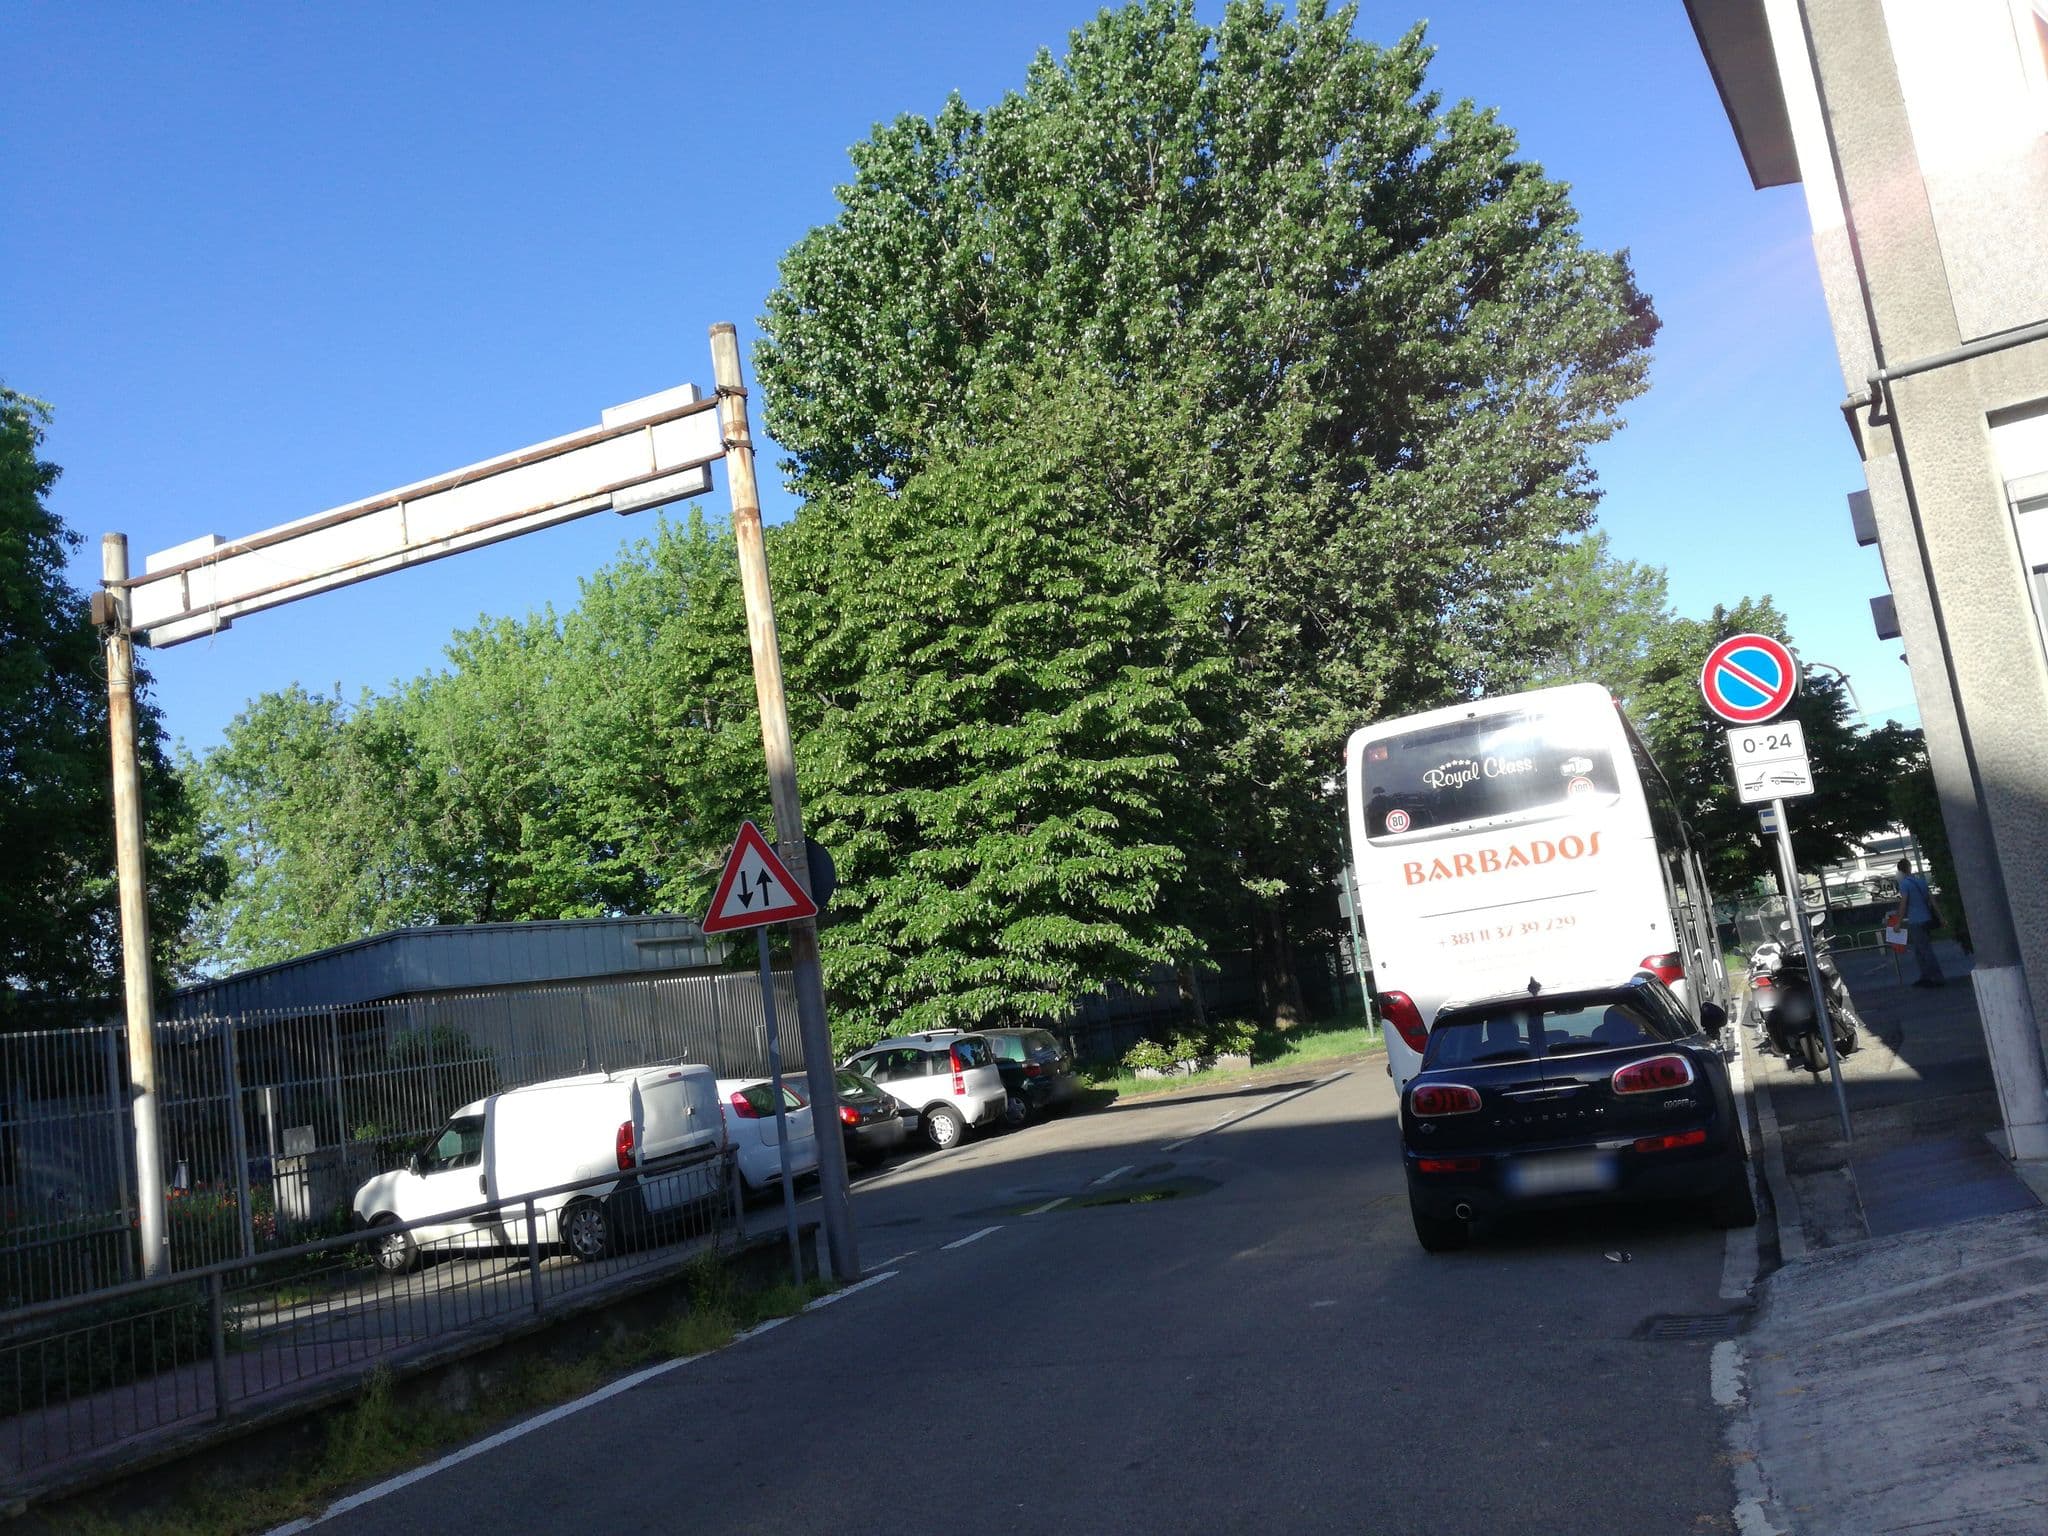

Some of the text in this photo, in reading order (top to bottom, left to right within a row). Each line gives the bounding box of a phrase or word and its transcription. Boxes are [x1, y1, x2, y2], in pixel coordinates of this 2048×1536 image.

[1423, 762, 1480, 788] Royal
[1484, 757, 1533, 777] Class
[1392, 815, 1404, 827] 80
[1403, 831, 1601, 886] BARBADOS
